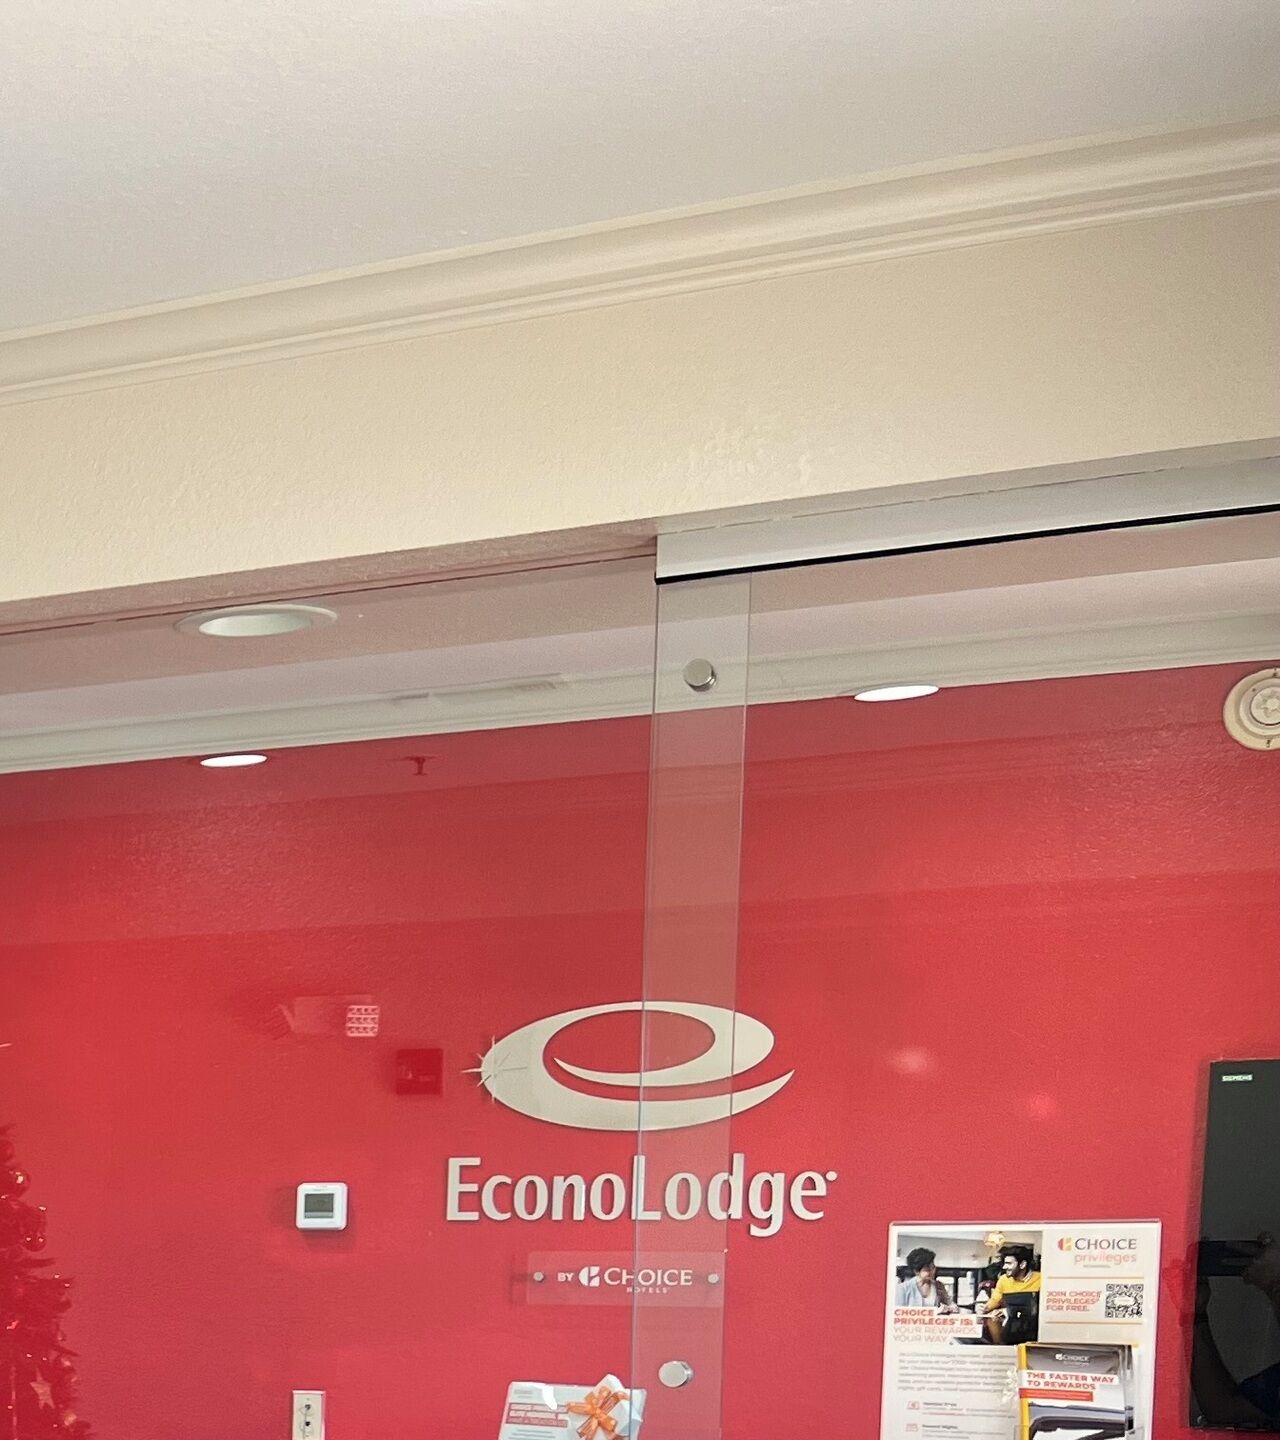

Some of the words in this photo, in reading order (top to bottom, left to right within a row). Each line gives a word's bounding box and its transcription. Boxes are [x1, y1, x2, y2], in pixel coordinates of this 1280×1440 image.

[1074, 1238, 1138, 1250] CHOICE
[1074, 1252, 1137, 1265] privileges
[557, 1272, 574, 1282] BY
[604, 1267, 693, 1286] CHOICE
[894, 1309, 934, 1317] CHOICE
[894, 1326, 921, 1334] YOUR
[894, 1335, 921, 1343] YOUR
[1027, 1372, 1046, 1380] THE
[1049, 1373, 1088, 1382] FASTER
[1091, 1375, 1114, 1383] WAY
[1043, 1381, 1096, 1390] REWARDS
